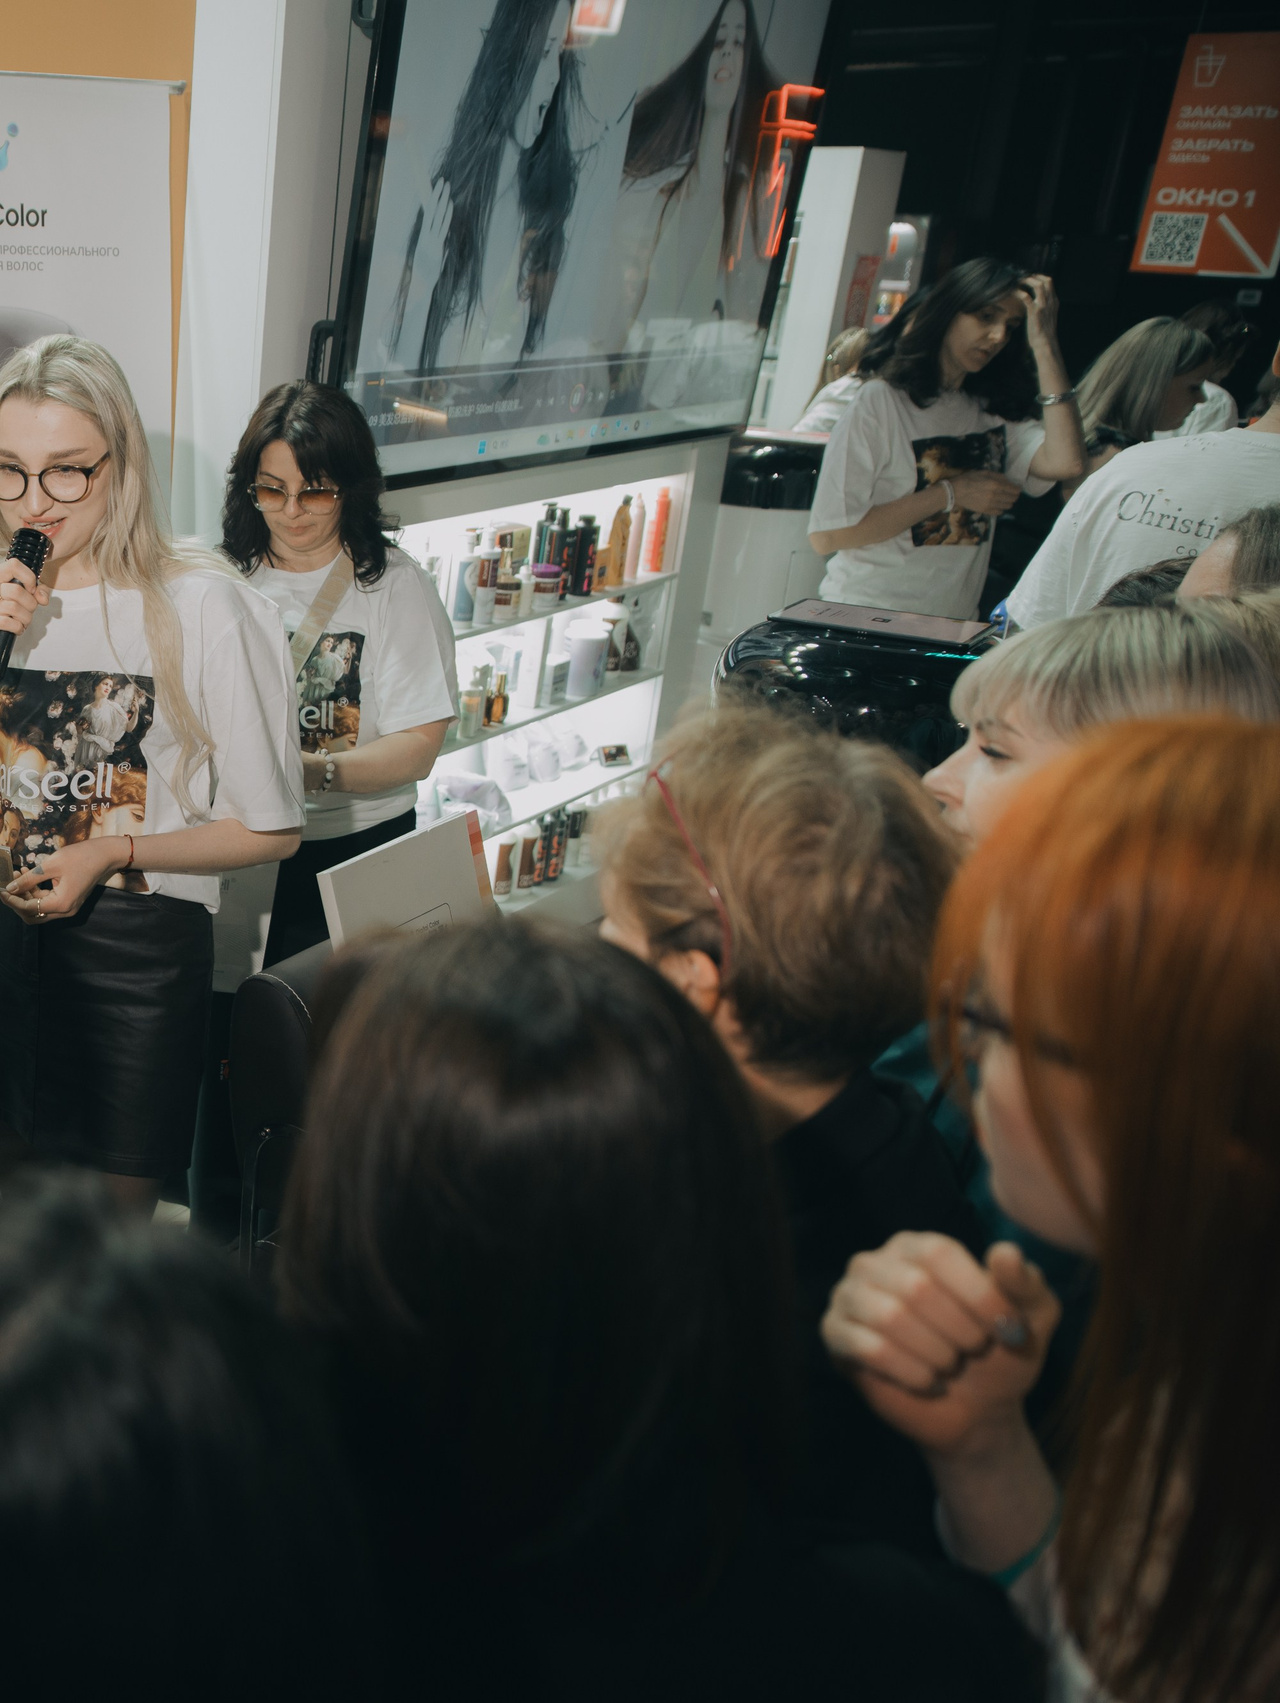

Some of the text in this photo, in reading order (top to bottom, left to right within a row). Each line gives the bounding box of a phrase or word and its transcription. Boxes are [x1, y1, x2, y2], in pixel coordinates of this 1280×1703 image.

[1180, 104, 1279, 119] ЗАКАЗАТЬ
[1176, 118, 1231, 130] ОНЛАЙН
[1171, 138, 1255, 152] ЗАБРАТЬ
[1167, 152, 1210, 163] ЗДЕСЬ
[1157, 187, 1256, 208] ОКНО 1
[6, 261, 44, 271] ВОЛОС
[46, 801, 111, 813] SYSTEM
